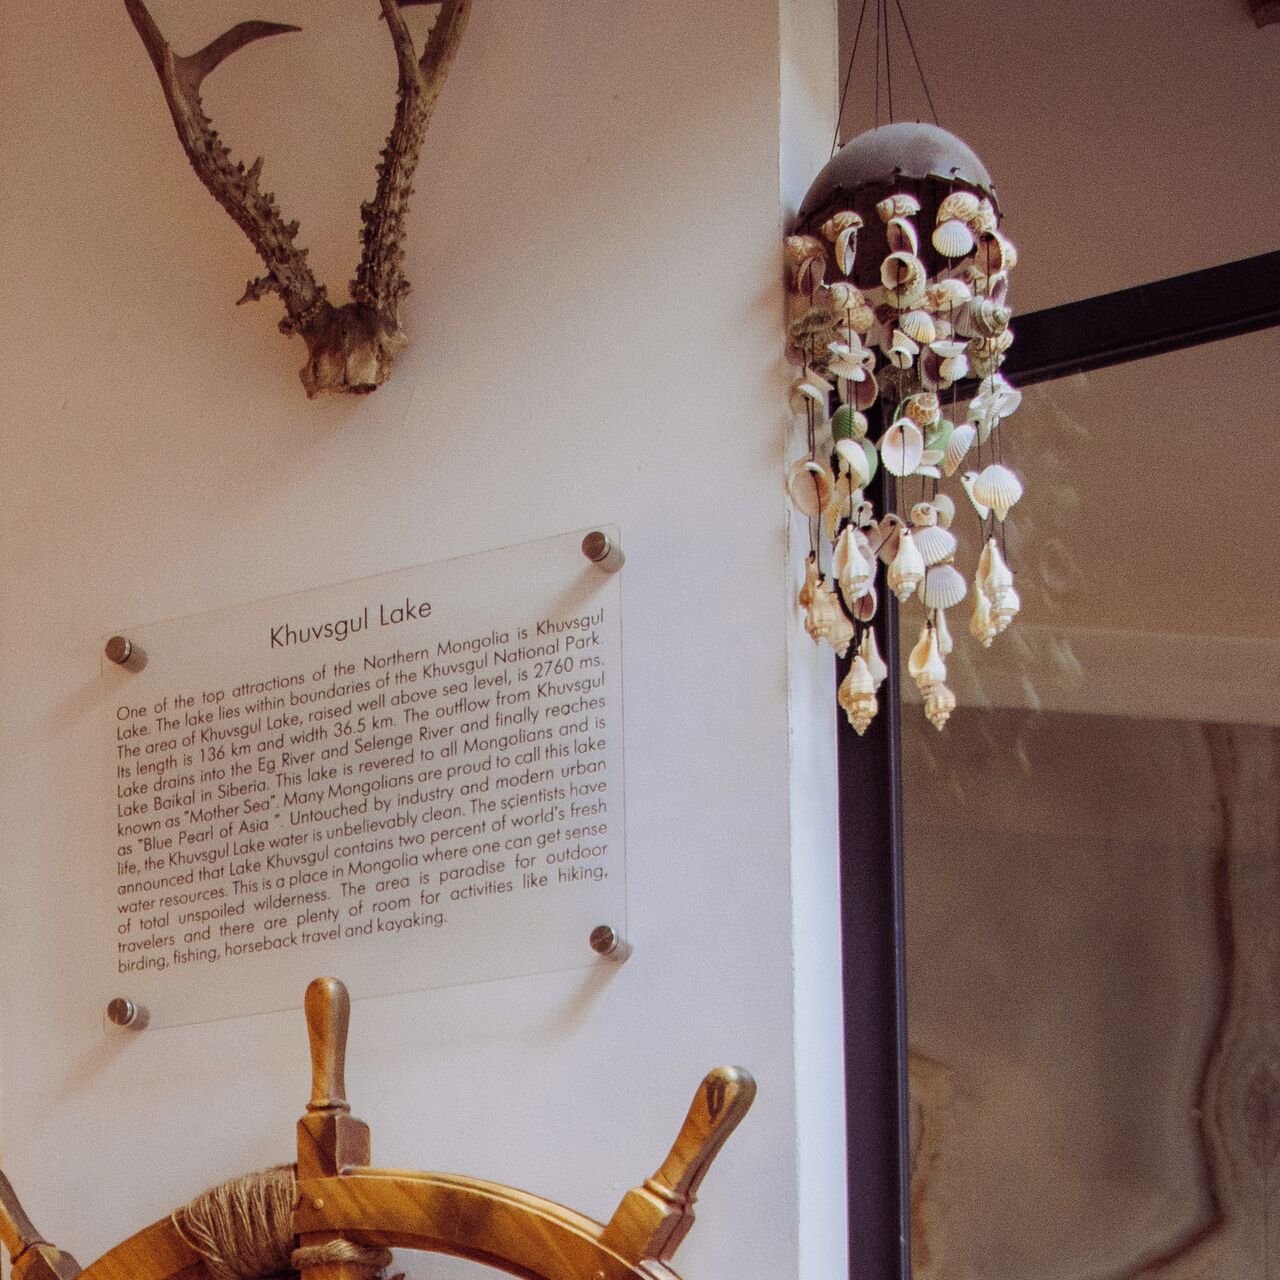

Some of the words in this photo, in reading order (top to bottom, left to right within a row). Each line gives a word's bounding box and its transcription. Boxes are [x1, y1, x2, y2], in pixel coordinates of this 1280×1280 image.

[116, 705, 147, 721] One
[153, 697, 167, 714] of
[174, 694, 195, 709] the
[202, 690, 225, 705] top
[232, 674, 305, 698] attractions
[312, 664, 326, 682] of
[333, 661, 356, 677] the
[363, 648, 429, 671] Northern
[436, 630, 509, 657] Mongolia
[517, 627, 528, 640] is
[536, 607, 604, 637] Khuvsgul
[270, 606, 368, 649] Khuvsgul
[380, 597, 432, 626] Lake
[116, 723, 151, 741] Lake.
[155, 716, 181, 732] The
[185, 710, 214, 727] lake
[218, 705, 240, 720] lies
[244, 695, 285, 714] within
[289, 680, 371, 706] boundaries
[375, 671, 390, 689] of
[394, 669, 417, 685] the
[423, 652, 488, 680] Khuvsgul
[493, 637, 560, 666] National
[565, 630, 605, 651] Park.
[116, 743, 141, 760] The
[145, 738, 177, 755] area
[181, 729, 196, 747] of
[200, 716, 261, 744] Khuvsgul
[266, 712, 304, 731] Lake,
[308, 699, 352, 722] raised
[356, 692, 386, 712] well
[390, 688, 437, 706] above
[442, 681, 468, 697] sea
[473, 668, 512, 690] level,
[517, 668, 528, 682] is
[533, 656, 574, 679] 2760
[579, 656, 604, 669] ms.
[117, 765, 131, 779] Its
[136, 754, 177, 776] length
[183, 753, 193, 766] is
[200, 744, 226, 763] 136
[231, 742, 251, 757] km
[256, 732, 284, 752] and
[289, 725, 328, 745] width
[333, 717, 366, 738] 36.5
[372, 714, 396, 731] km.
[403, 707, 430, 724] The
[435, 697, 490, 718] outflow
[496, 690, 531, 707] from
[537, 670, 605, 699] Khuvsgul
[117, 780, 148, 799] Lake
[153, 774, 195, 792] drains
[200, 767, 226, 783] into
[230, 761, 252, 777] the
[257, 756, 276, 774] Eg
[281, 751, 316, 768] River
[320, 740, 349, 760] and
[354, 733, 413, 754] Selenge
[419, 725, 454, 741] River
[460, 713, 489, 734] and
[495, 706, 539, 727] finally
[545, 695, 606, 718] reaches
[117, 800, 148, 818] Lake
[153, 789, 195, 811] Baikal
[201, 789, 212, 803] in
[217, 779, 270, 800] Siberia.
[275, 772, 303, 788] This
[307, 764, 337, 783] lake
[343, 762, 353, 776] is
[358, 747, 414, 773] revered
[420, 749, 435, 761] to
[440, 740, 458, 758] all
[463, 727, 553, 754] Mongolians
[558, 716, 589, 736] and
[595, 716, 606, 729] is
[117, 820, 161, 837] known
[164, 816, 181, 828] as
[183, 804, 240, 824] "Mother
[243, 794, 279, 815] Sea".
[283, 790, 325, 807] Many
[327, 774, 414, 799] Mongolians
[417, 769, 443, 783] are
[446, 754, 492, 781] proud
[496, 755, 511, 768] to
[514, 745, 541, 766] call
[545, 743, 570, 760] this
[574, 736, 606, 755] lake
[117, 860, 141, 876] life,
[144, 856, 165, 871] the
[168, 842, 229, 867] Khuvsgul
[233, 838, 265, 856] Lake
[268, 833, 309, 849] water
[312, 828, 323, 842] is
[326, 810, 418, 840] unbelievably
[421, 805, 465, 823] clean.
[469, 798, 497, 814] The
[500, 787, 566, 810] scientists
[569, 781, 607, 797] have
[117, 868, 194, 896] announced
[198, 865, 225, 882] that
[229, 858, 262, 877] Lake
[266, 844, 329, 870] Khuvsgul
[333, 838, 394, 859] contains
[398, 833, 425, 847] two
[430, 820, 486, 846] percent
[491, 814, 506, 832] of
[510, 805, 565, 828] world's
[570, 798, 607, 818] fresh
[117, 917, 131, 935] of
[139, 911, 170, 930] total
[178, 899, 245, 925] unspoiled
[253, 890, 331, 911] wilderness.
[340, 881, 366, 897] The
[375, 877, 410, 892] area
[419, 871, 430, 885] is
[439, 860, 506, 886] paradise
[515, 854, 536, 869] for
[546, 844, 608, 865] outdoor
[117, 933, 175, 954] travelers
[183, 924, 211, 943] and
[219, 921, 255, 937] there
[263, 917, 287, 930] are
[296, 907, 339, 929] plenty
[348, 899, 363, 917] of
[372, 897, 411, 913] room
[420, 890, 441, 905] for
[450, 880, 513, 901] activities
[522, 873, 548, 889] like
[558, 866, 608, 883] hiking,
[118, 955, 170, 974] birding,
[173, 947, 221, 964] fishing,
[224, 931, 298, 956] horseback
[301, 923, 341, 944] travel
[344, 918, 373, 938] and
[377, 912, 447, 933] kayaking.
